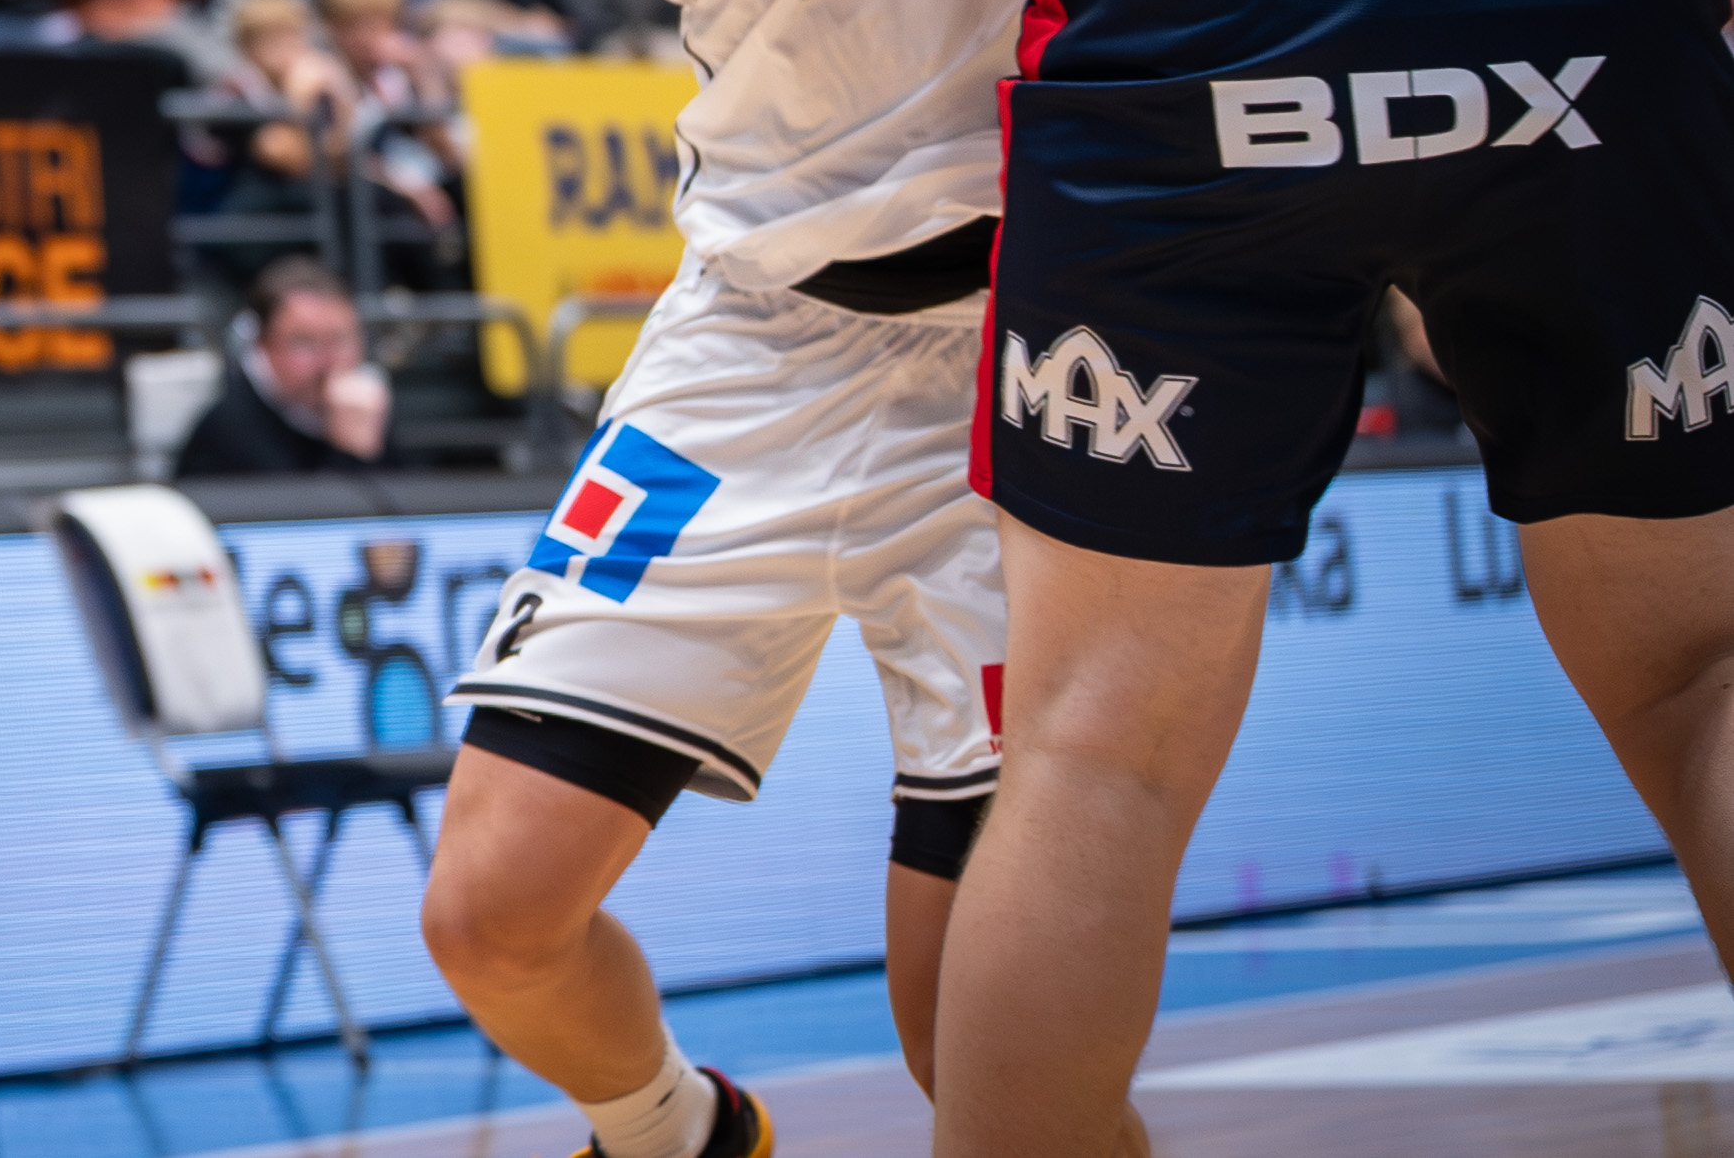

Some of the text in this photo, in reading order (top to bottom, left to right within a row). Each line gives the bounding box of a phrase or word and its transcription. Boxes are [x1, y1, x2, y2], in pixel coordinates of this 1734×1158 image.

[1209, 55, 1607, 168] BDX
[1000, 324, 1199, 472] MAX
[1625, 294, 1734, 442] MA
